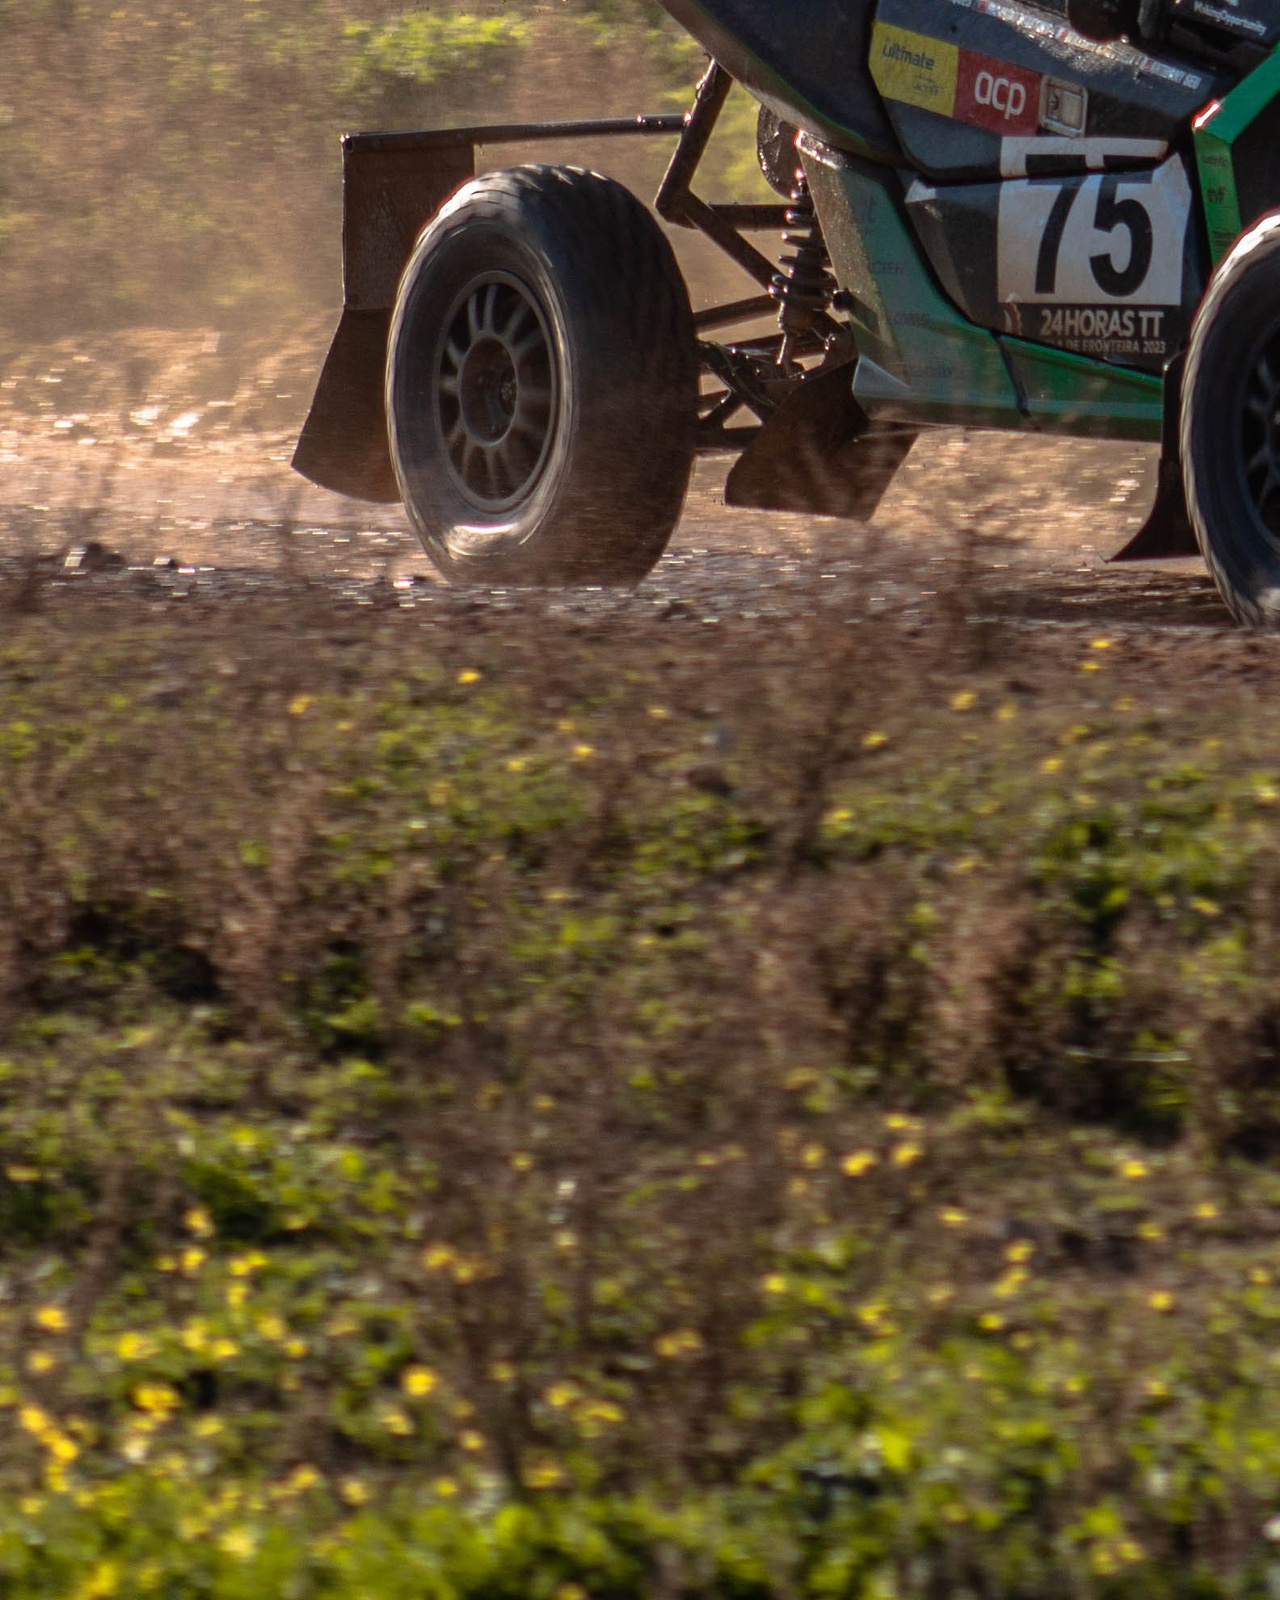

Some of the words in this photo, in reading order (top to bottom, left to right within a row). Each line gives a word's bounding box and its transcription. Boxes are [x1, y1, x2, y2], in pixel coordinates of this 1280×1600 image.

[974, 71, 1026, 120] acp
[1025, 153, 1153, 297] 75
[1138, 310, 1165, 338] TT
[1083, 339, 1140, 353] FRONTEIRA
[1143, 341, 1166, 354] 2023
